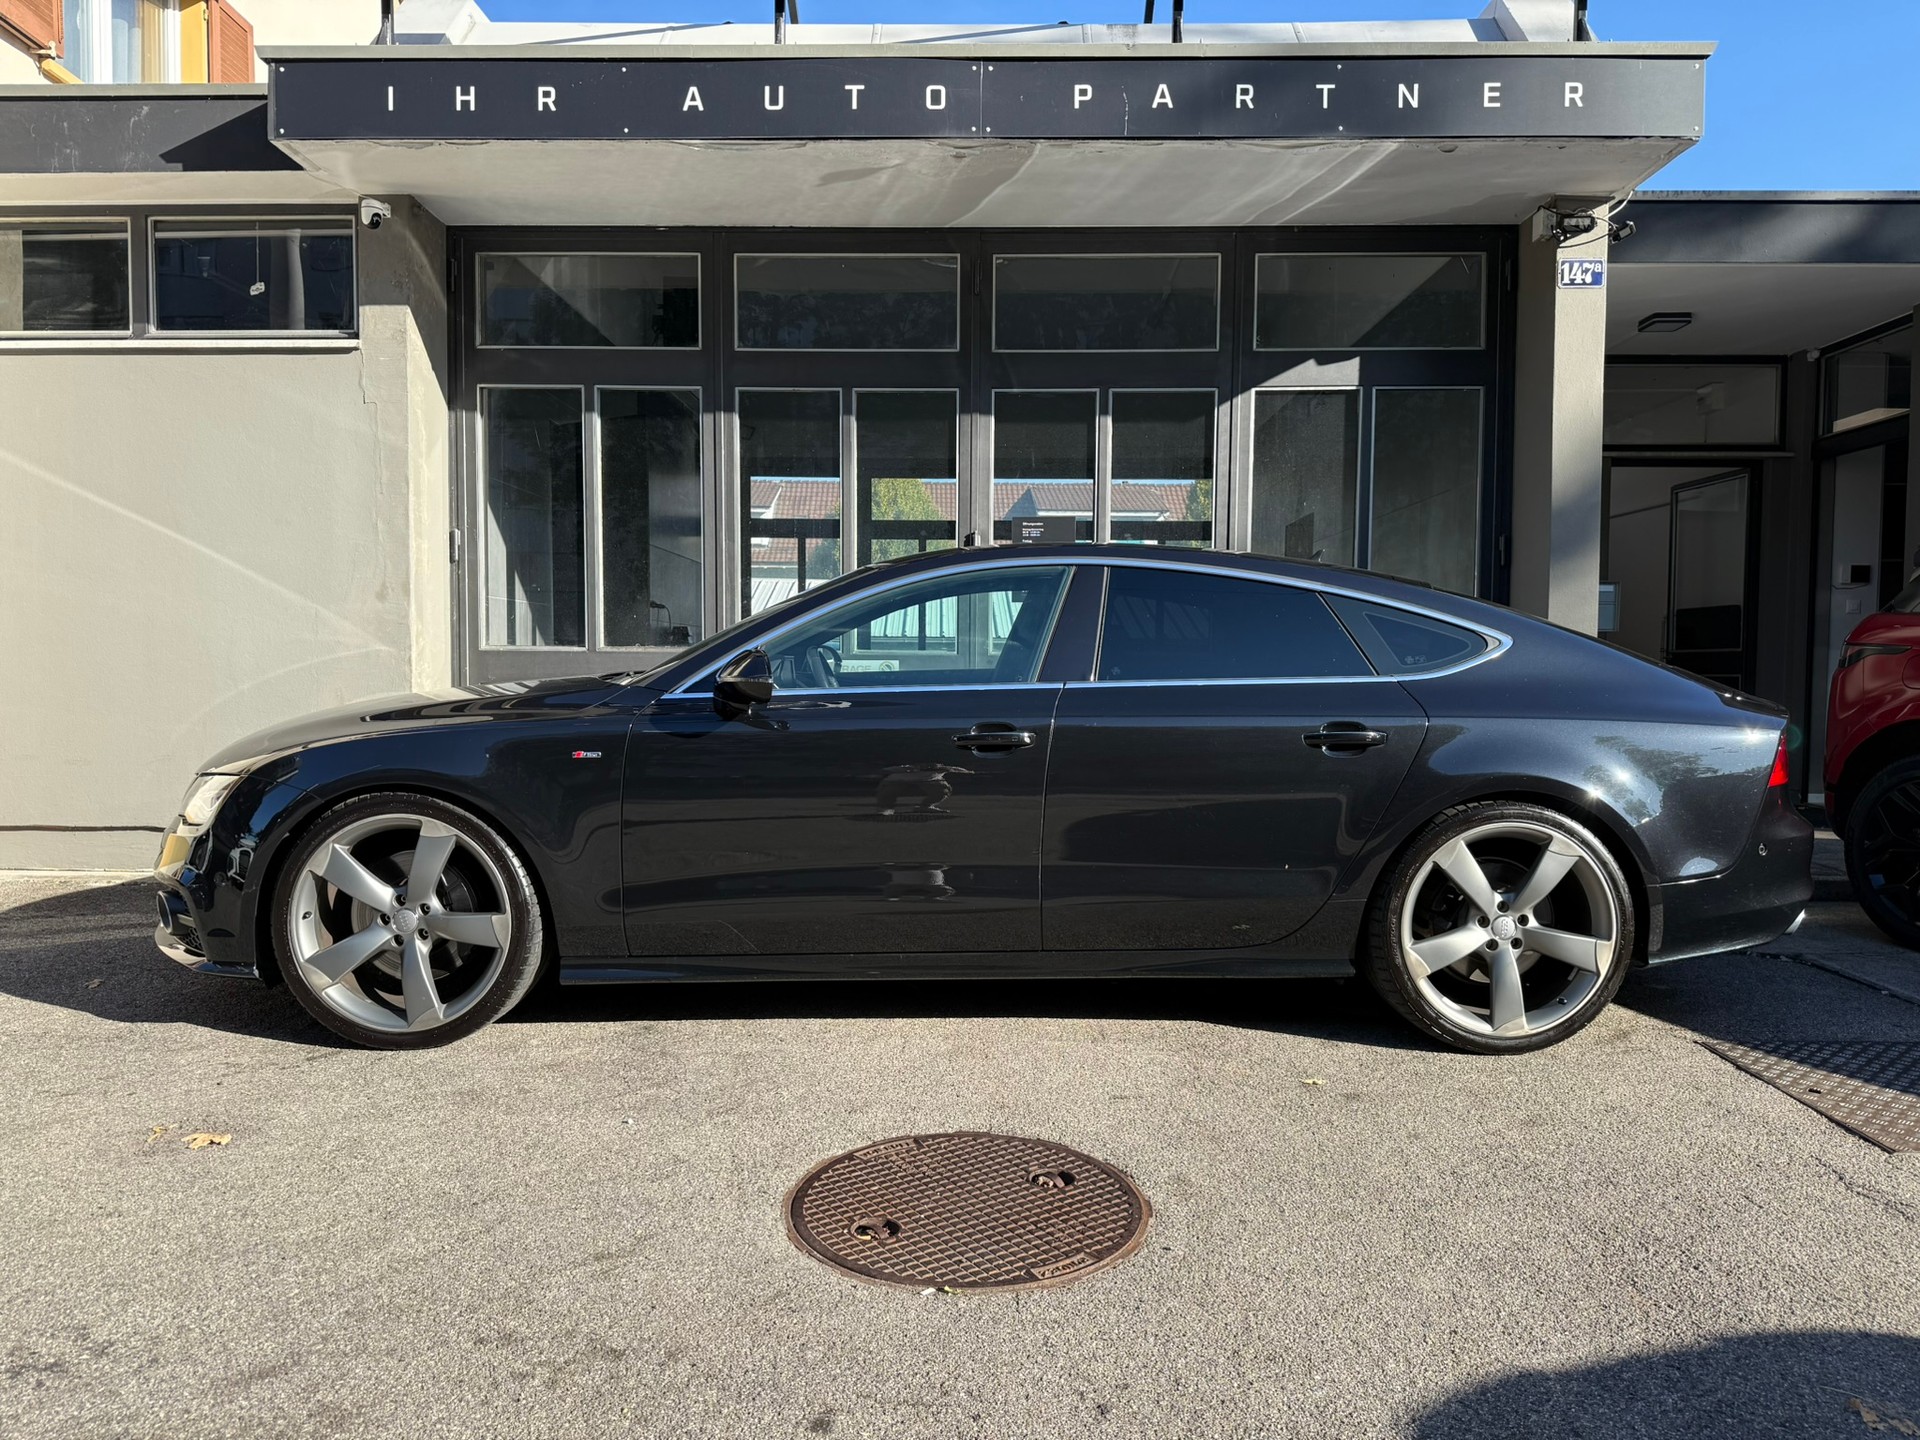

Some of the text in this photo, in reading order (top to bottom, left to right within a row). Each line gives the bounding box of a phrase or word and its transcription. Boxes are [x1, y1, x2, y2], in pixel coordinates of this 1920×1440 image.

[387, 81, 1585, 112] IHR AUTO PARTNER
[1561, 262, 1602, 284] 147a
